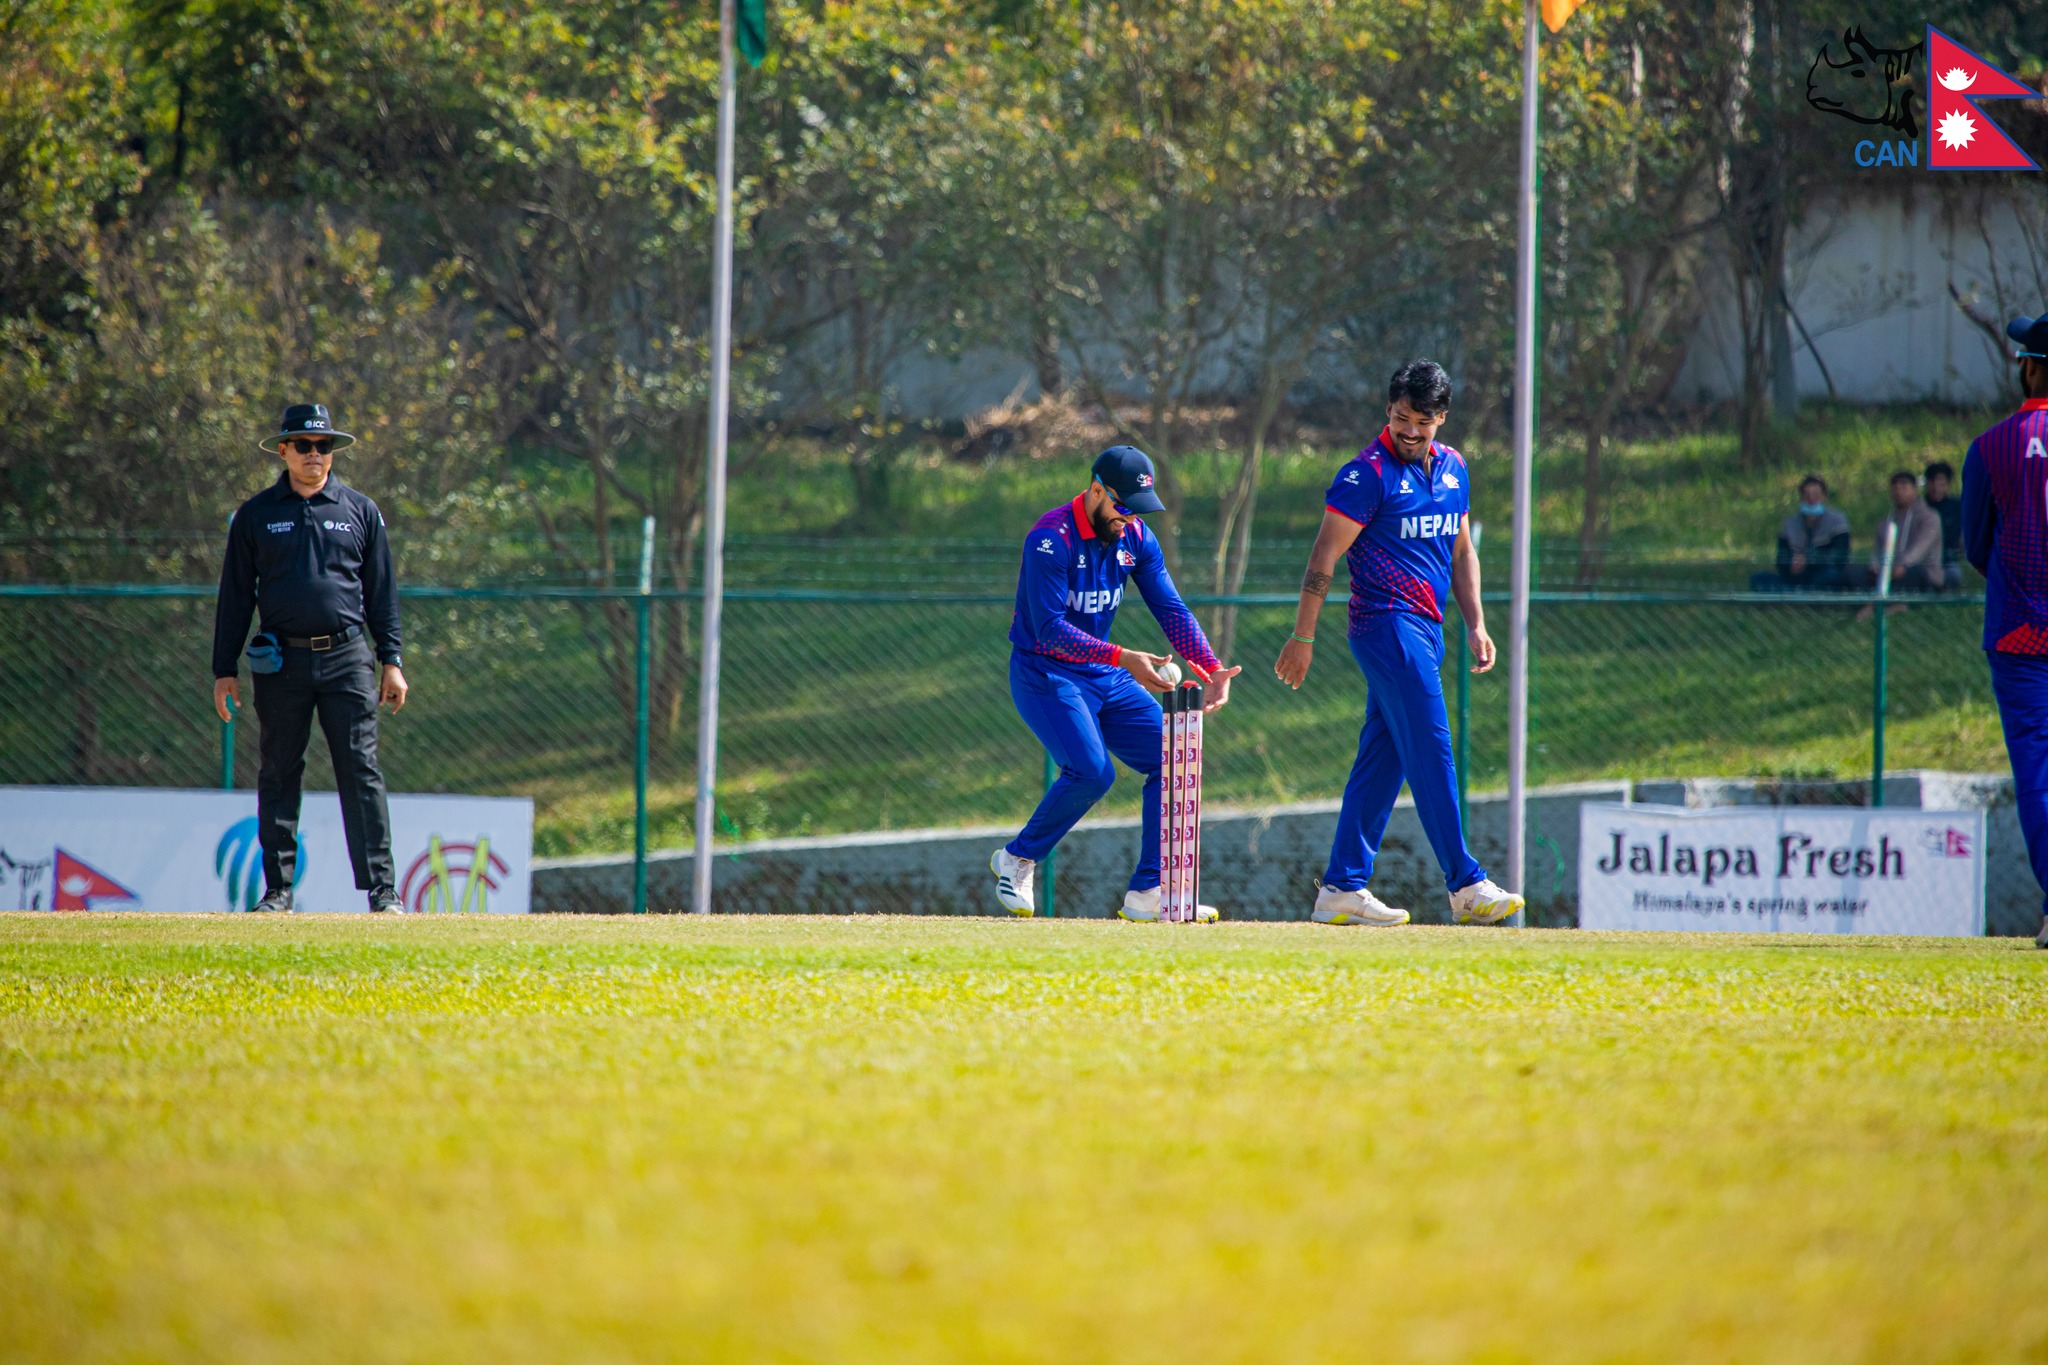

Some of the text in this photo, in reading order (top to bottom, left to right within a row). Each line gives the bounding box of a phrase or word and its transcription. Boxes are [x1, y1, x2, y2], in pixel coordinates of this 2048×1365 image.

[334, 521, 351, 532] ICC
[1400, 512, 1460, 540] NEPAL
[1598, 830, 1905, 886] Jalapa Fresh
[1633, 891, 1868, 921] Himalaya's spring water
